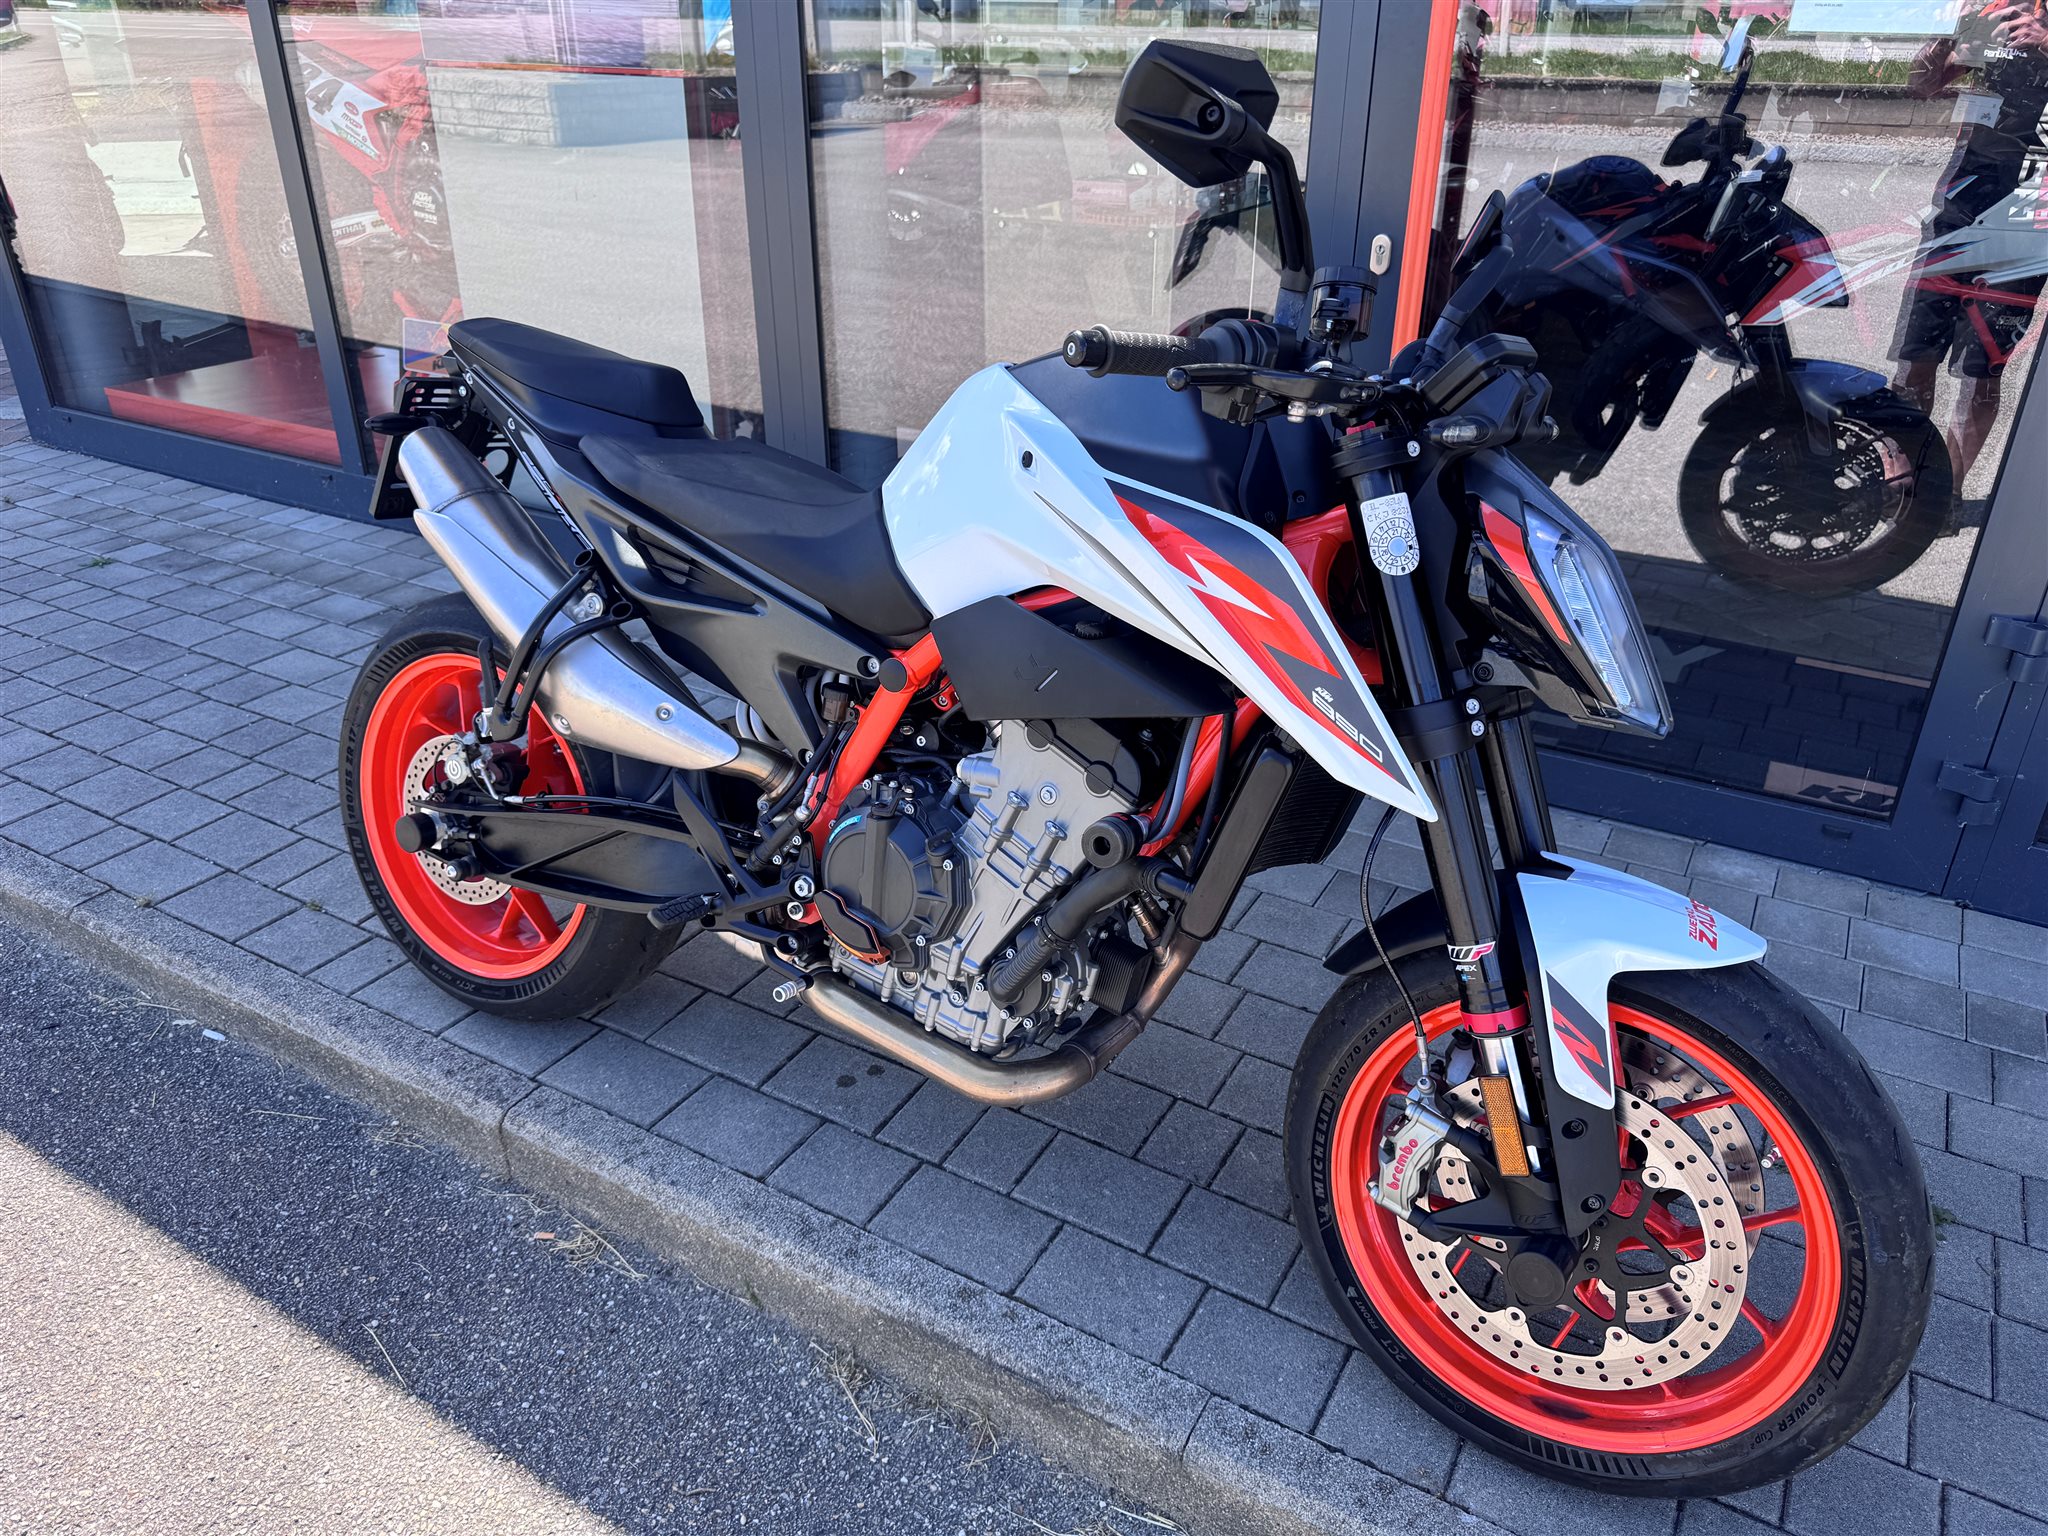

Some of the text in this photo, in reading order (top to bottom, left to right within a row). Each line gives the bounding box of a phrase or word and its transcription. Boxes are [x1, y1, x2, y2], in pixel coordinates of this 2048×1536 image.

[1331, 1045, 1362, 1090] 120/70
[1362, 1027, 1379, 1045] ZR
[1379, 1014, 1393, 1028] 17
[1313, 1097, 1335, 1199] MICHELIN
[1386, 1138, 1419, 1191] brembo
[1356, 1300, 1379, 1330] FRONT
[1829, 1256, 1864, 1375] MICHELIN
[1777, 1383, 1826, 1433] POWER
